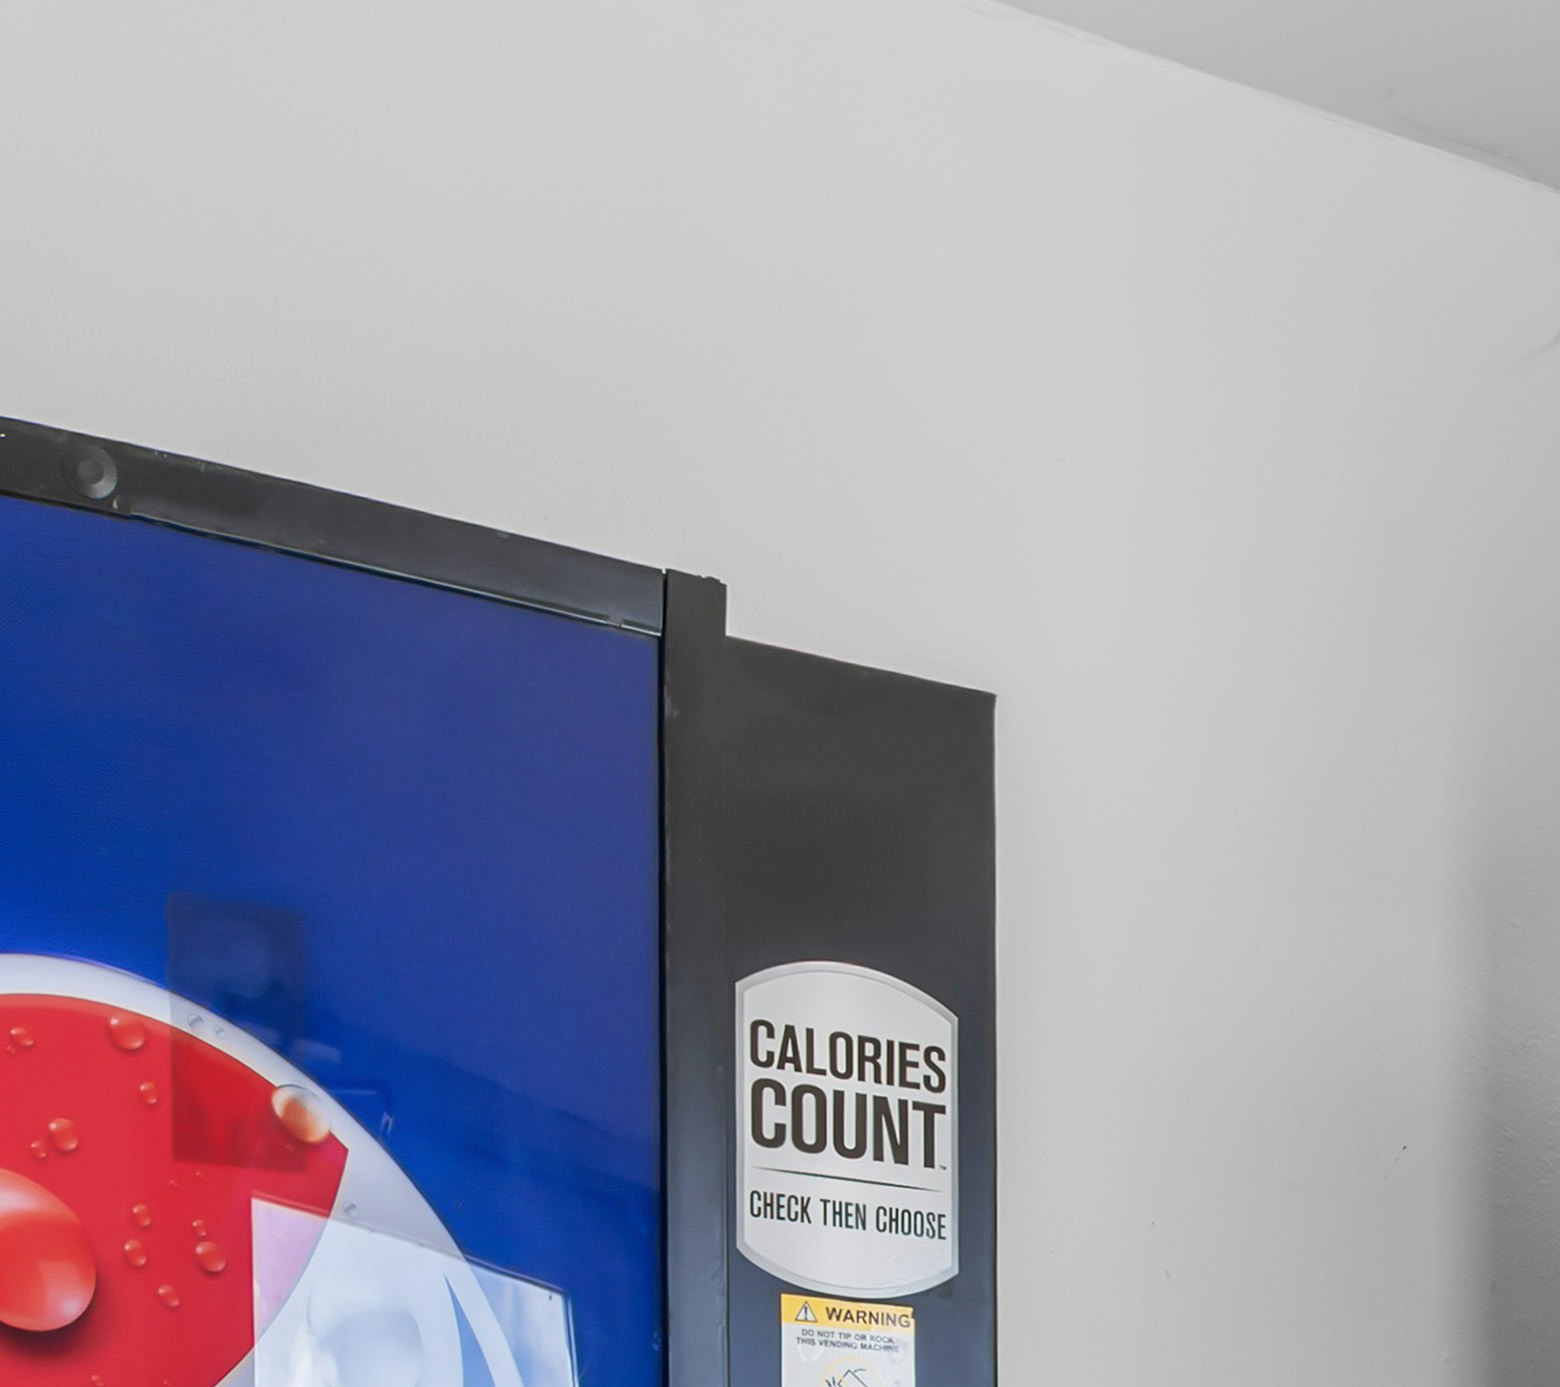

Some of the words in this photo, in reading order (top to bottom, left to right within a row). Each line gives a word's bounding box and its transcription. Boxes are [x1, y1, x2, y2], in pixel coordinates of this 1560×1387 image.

[749, 1018, 947, 1094] CALORIES
[749, 1189, 812, 1224] CHECK
[819, 1198, 867, 1231] THEN
[875, 1205, 947, 1240] CHOOSE
[825, 1306, 911, 1328] WARNING
[796, 1336, 816, 1346] THIS
[818, 1339, 858, 1350] VENDING
[859, 1342, 900, 1353] MACHINE
[801, 1328, 815, 1337] DO
[817, 1330, 835, 1338] NOT
[838, 1331, 851, 1340] TIP
[854, 1333, 867, 1341] OR
[869, 1334, 894, 1344] ROCK
